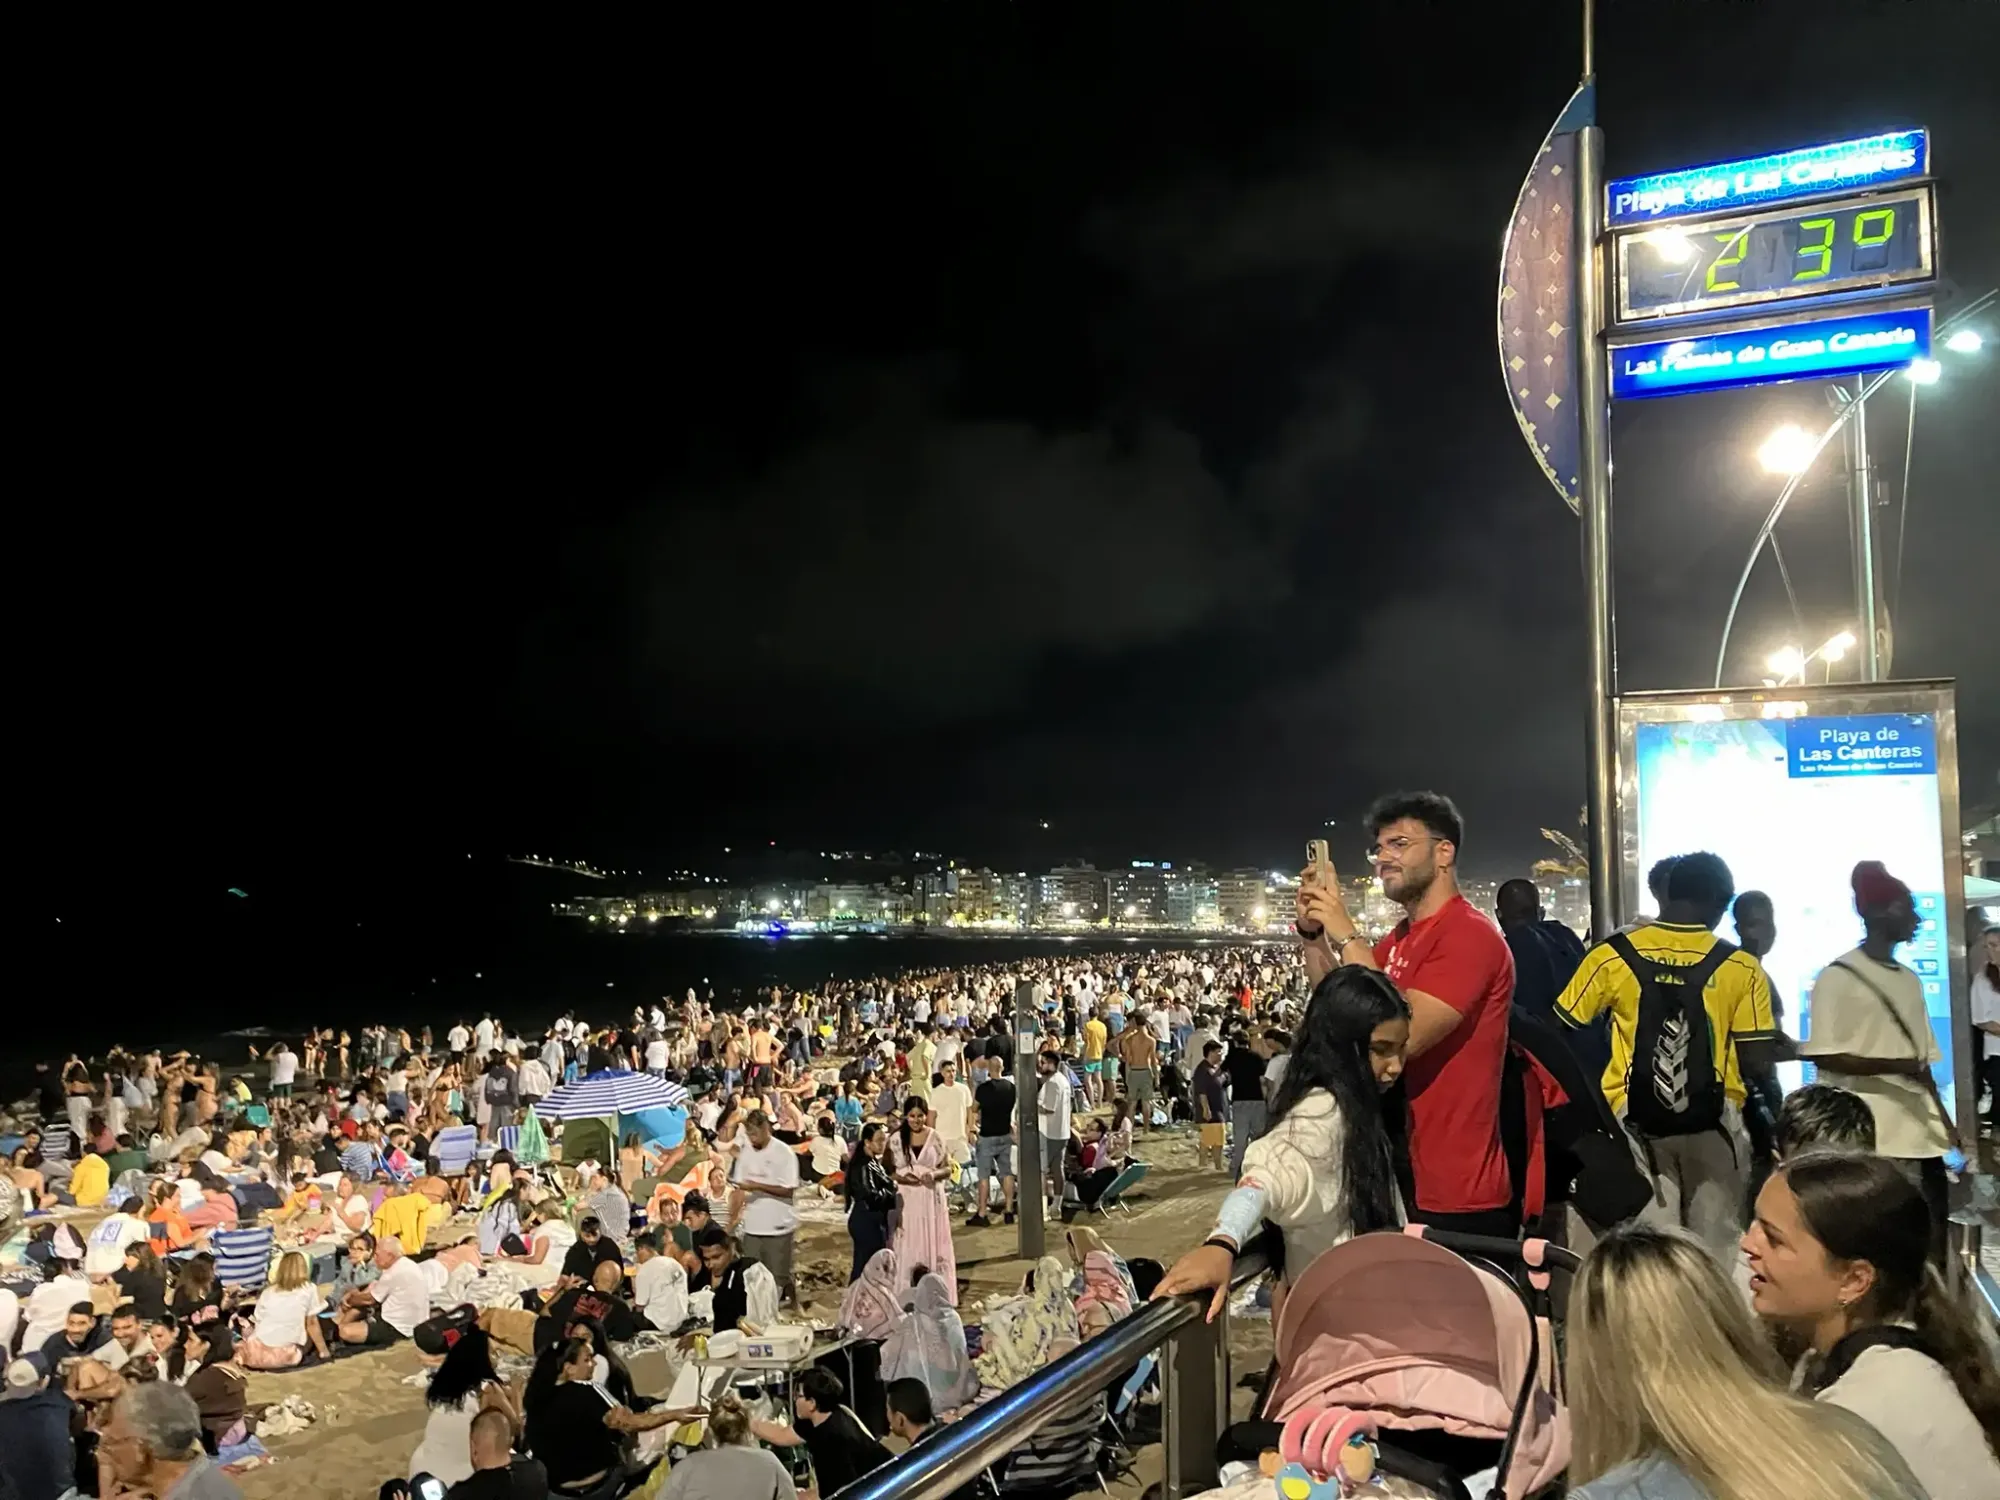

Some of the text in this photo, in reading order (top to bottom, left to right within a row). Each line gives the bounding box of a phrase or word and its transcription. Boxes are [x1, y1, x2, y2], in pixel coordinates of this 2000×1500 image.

[1616, 186, 1684, 215] Playa
[1693, 179, 1728, 201] de
[1625, 360, 1657, 376] Las
[1736, 345, 1765, 363] de
[1769, 340, 1825, 359] Gran
[1820, 727, 1899, 745] Playa de
[1799, 745, 1923, 761] Las Canteras
